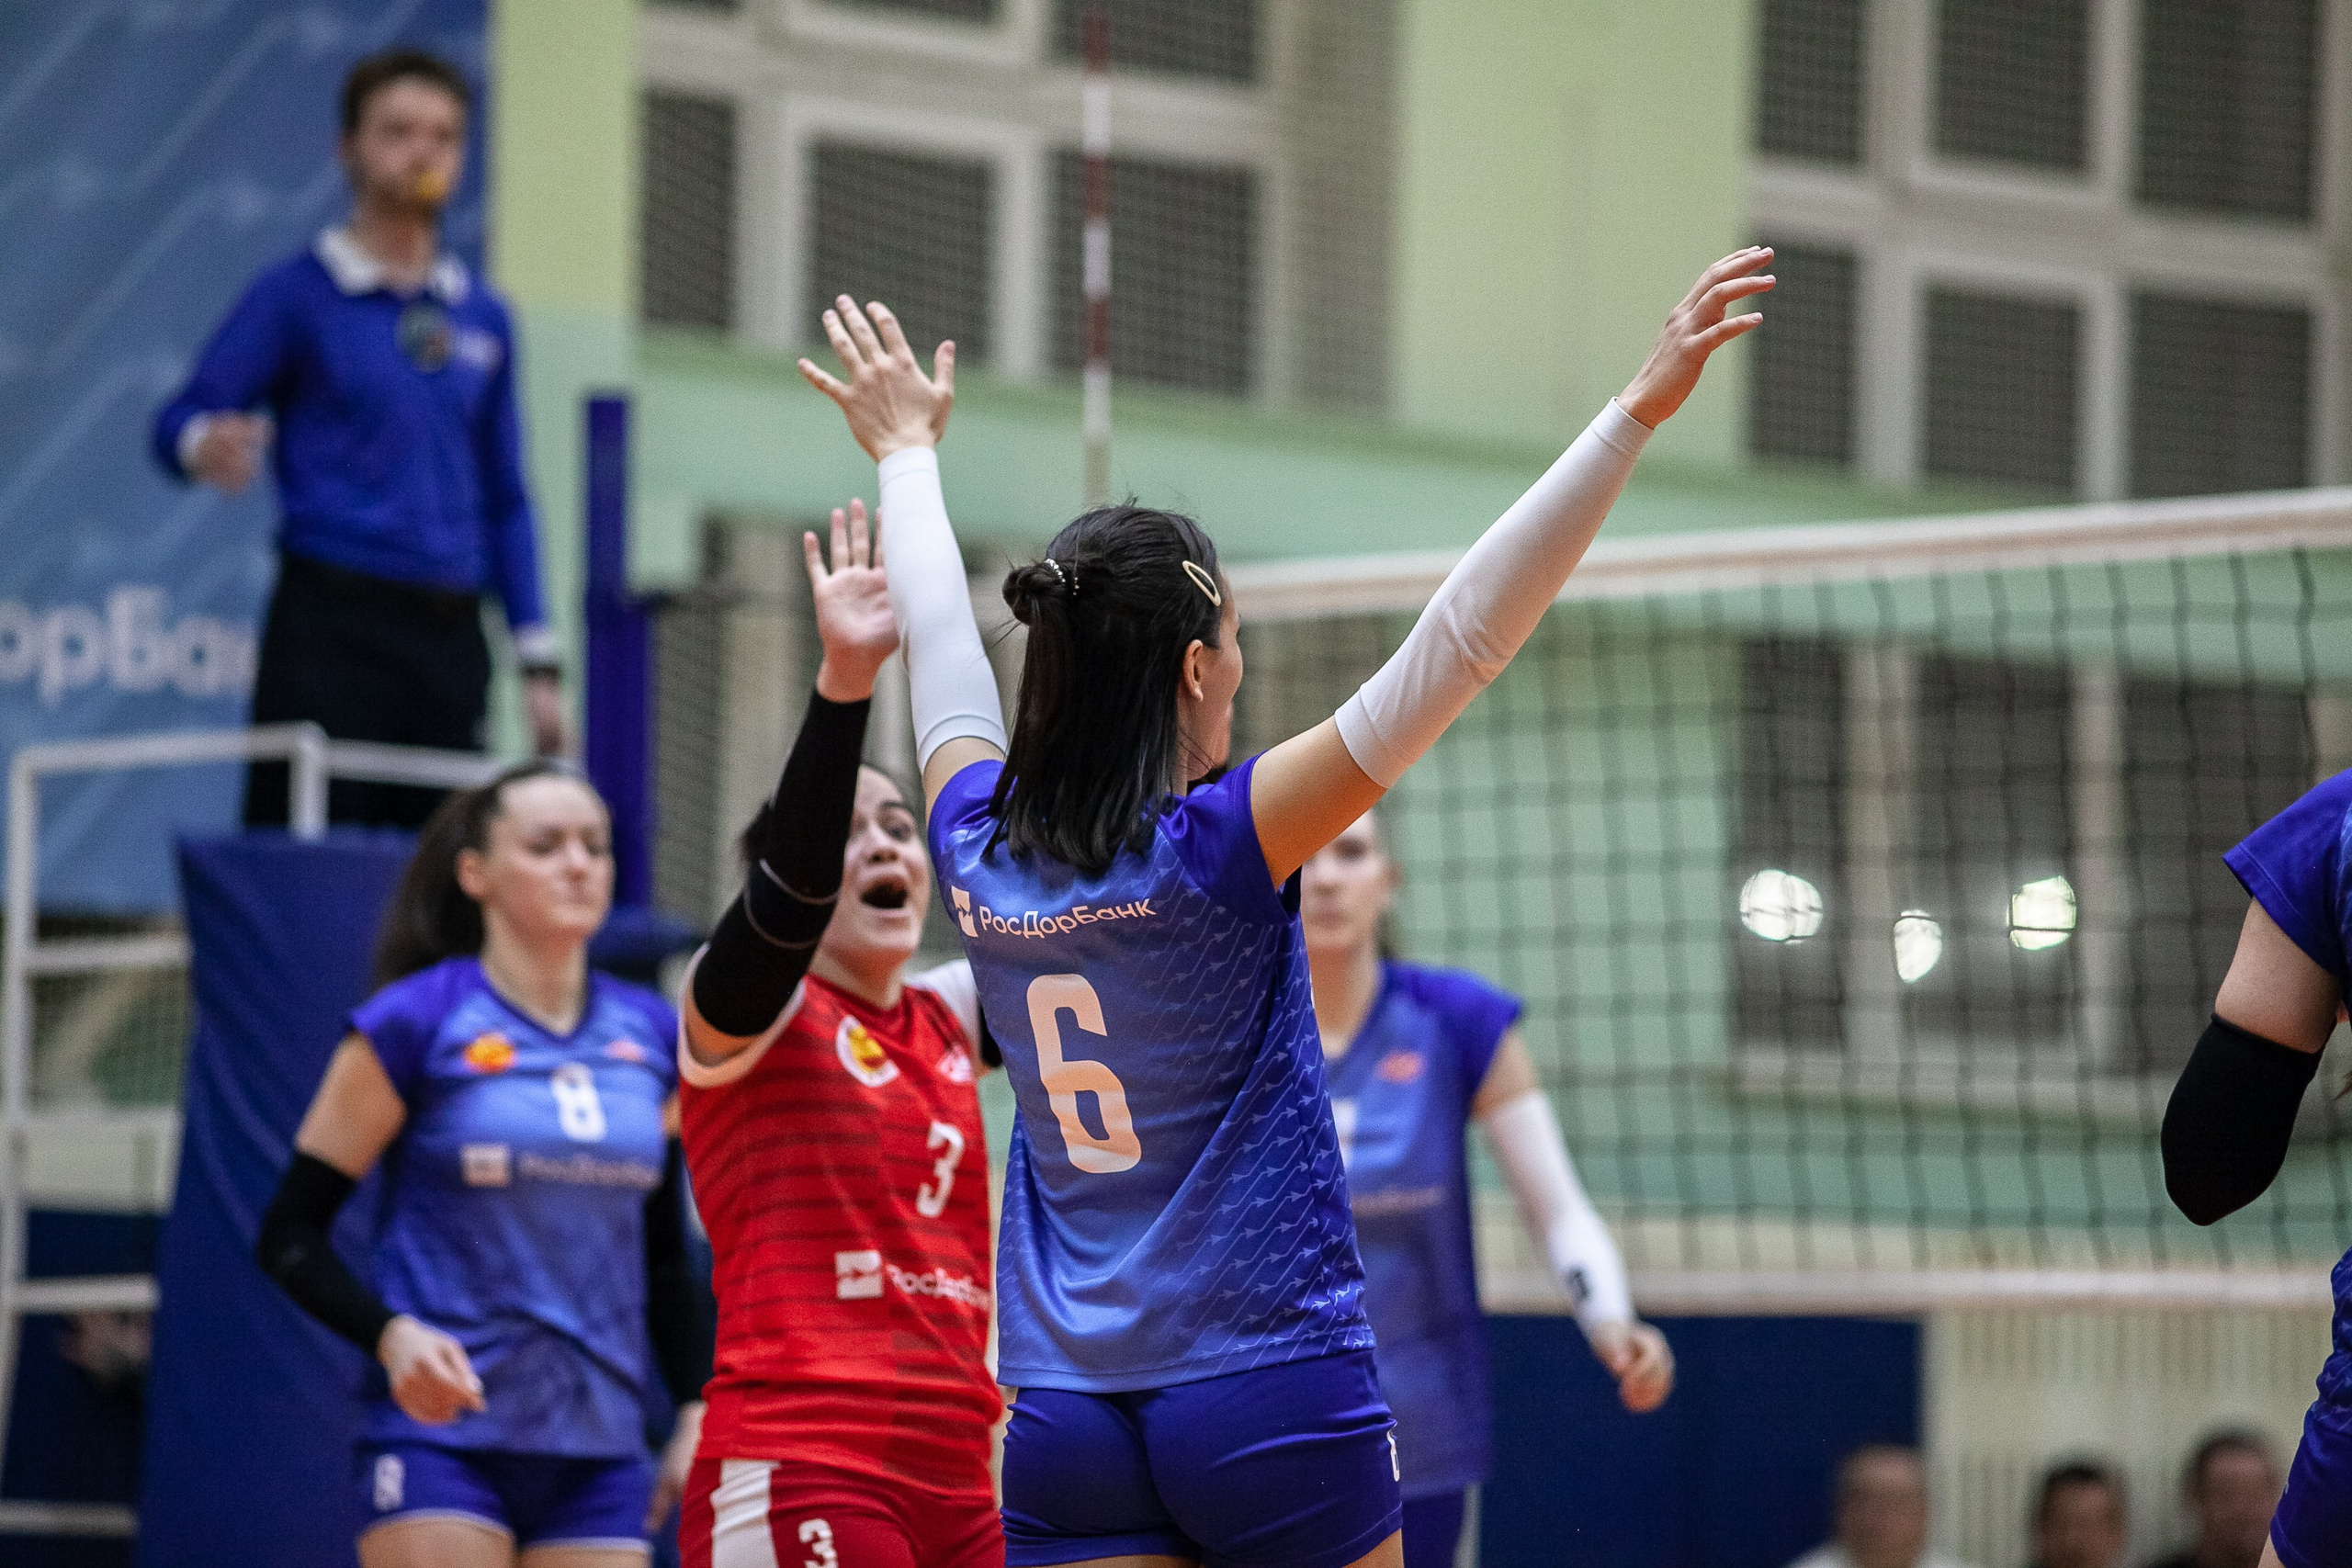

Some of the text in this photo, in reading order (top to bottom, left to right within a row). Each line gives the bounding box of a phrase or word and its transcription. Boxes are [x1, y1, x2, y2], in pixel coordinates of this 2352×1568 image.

[979, 898, 1157, 939] РосДорБанк
[551, 1063, 607, 1142] 8
[1026, 973, 1142, 1174] 6
[916, 1121, 965, 1218] 3
[797, 1517, 840, 1568] 3
